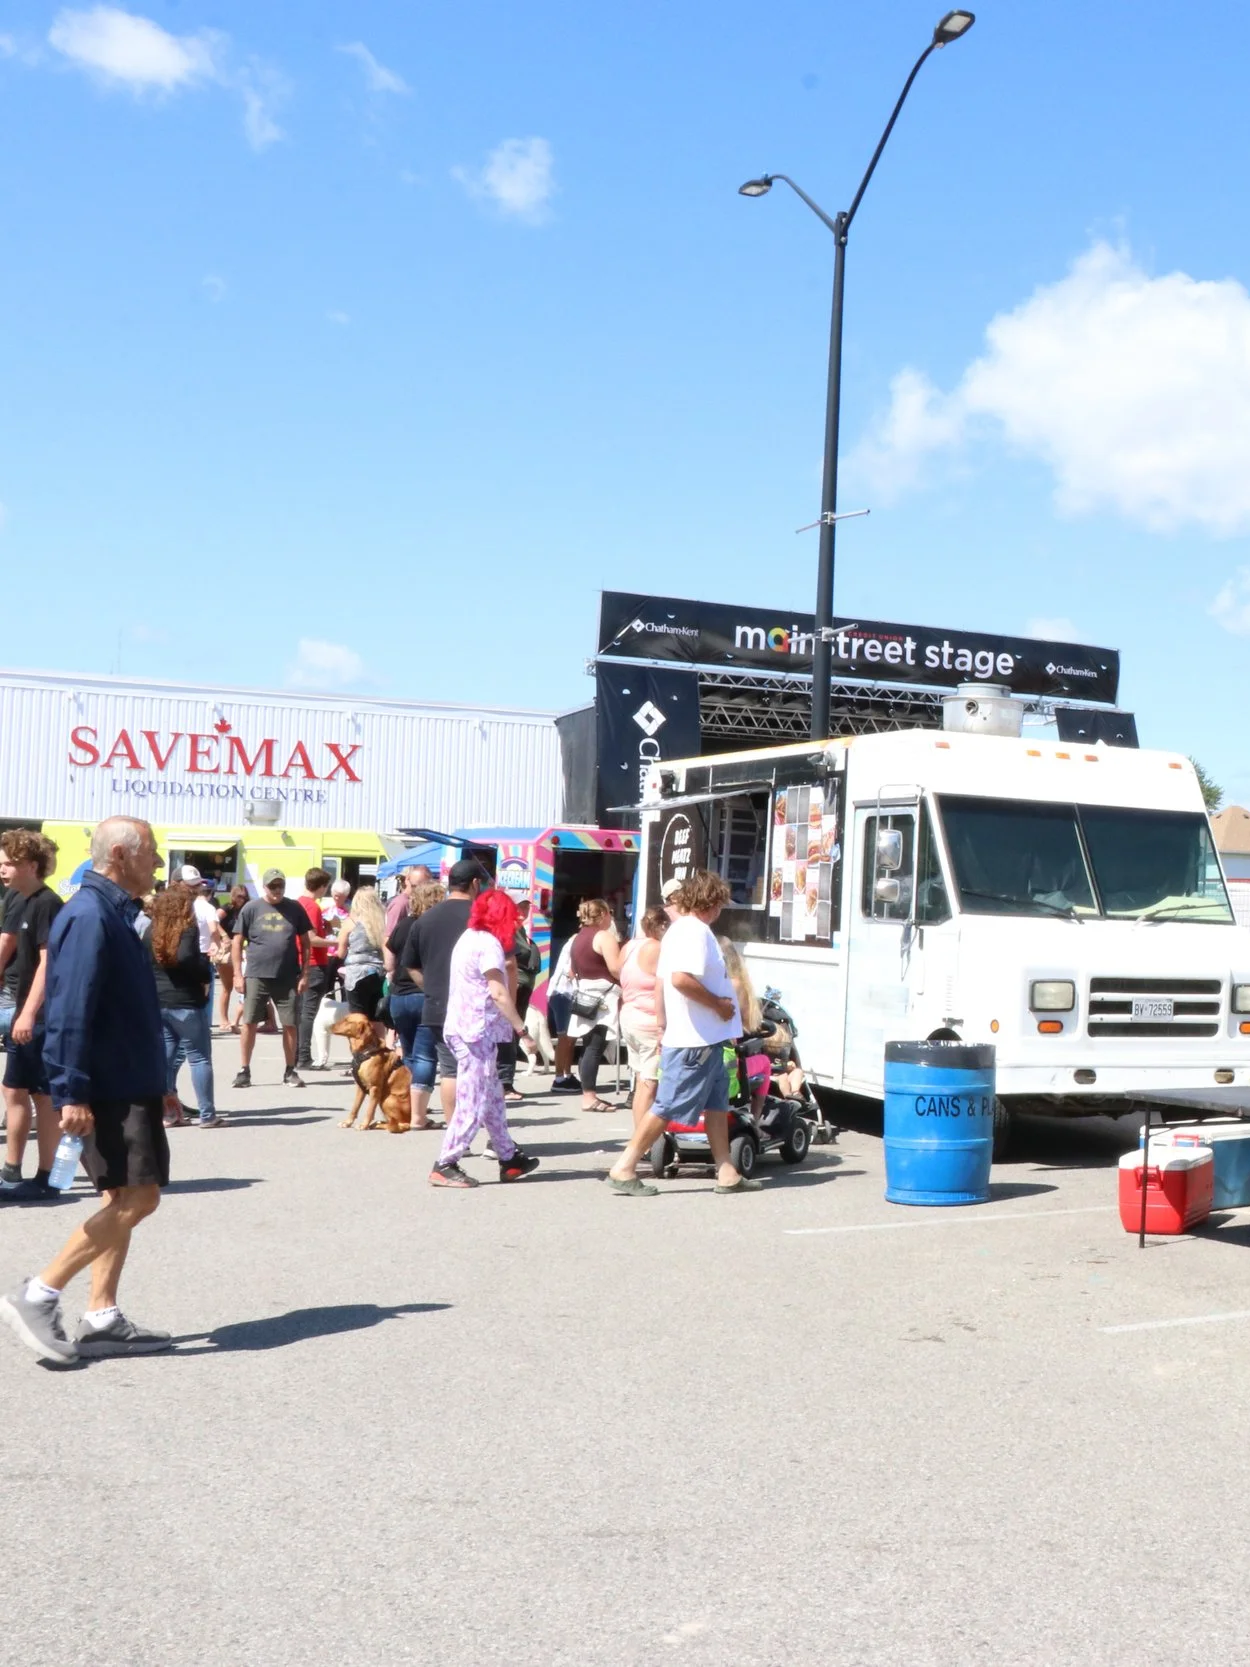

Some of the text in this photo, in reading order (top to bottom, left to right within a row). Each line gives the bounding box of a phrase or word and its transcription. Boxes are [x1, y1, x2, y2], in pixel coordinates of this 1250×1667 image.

[645, 622, 699, 637] Chatham-Kent
[734, 624, 1015, 679] maintreet stage
[68, 726, 363, 783] SAVEMAX
[112, 778, 328, 804] LIQUIDATION CENTRE
[915, 1095, 961, 1117] CANS
[967, 1095, 976, 1117] &
